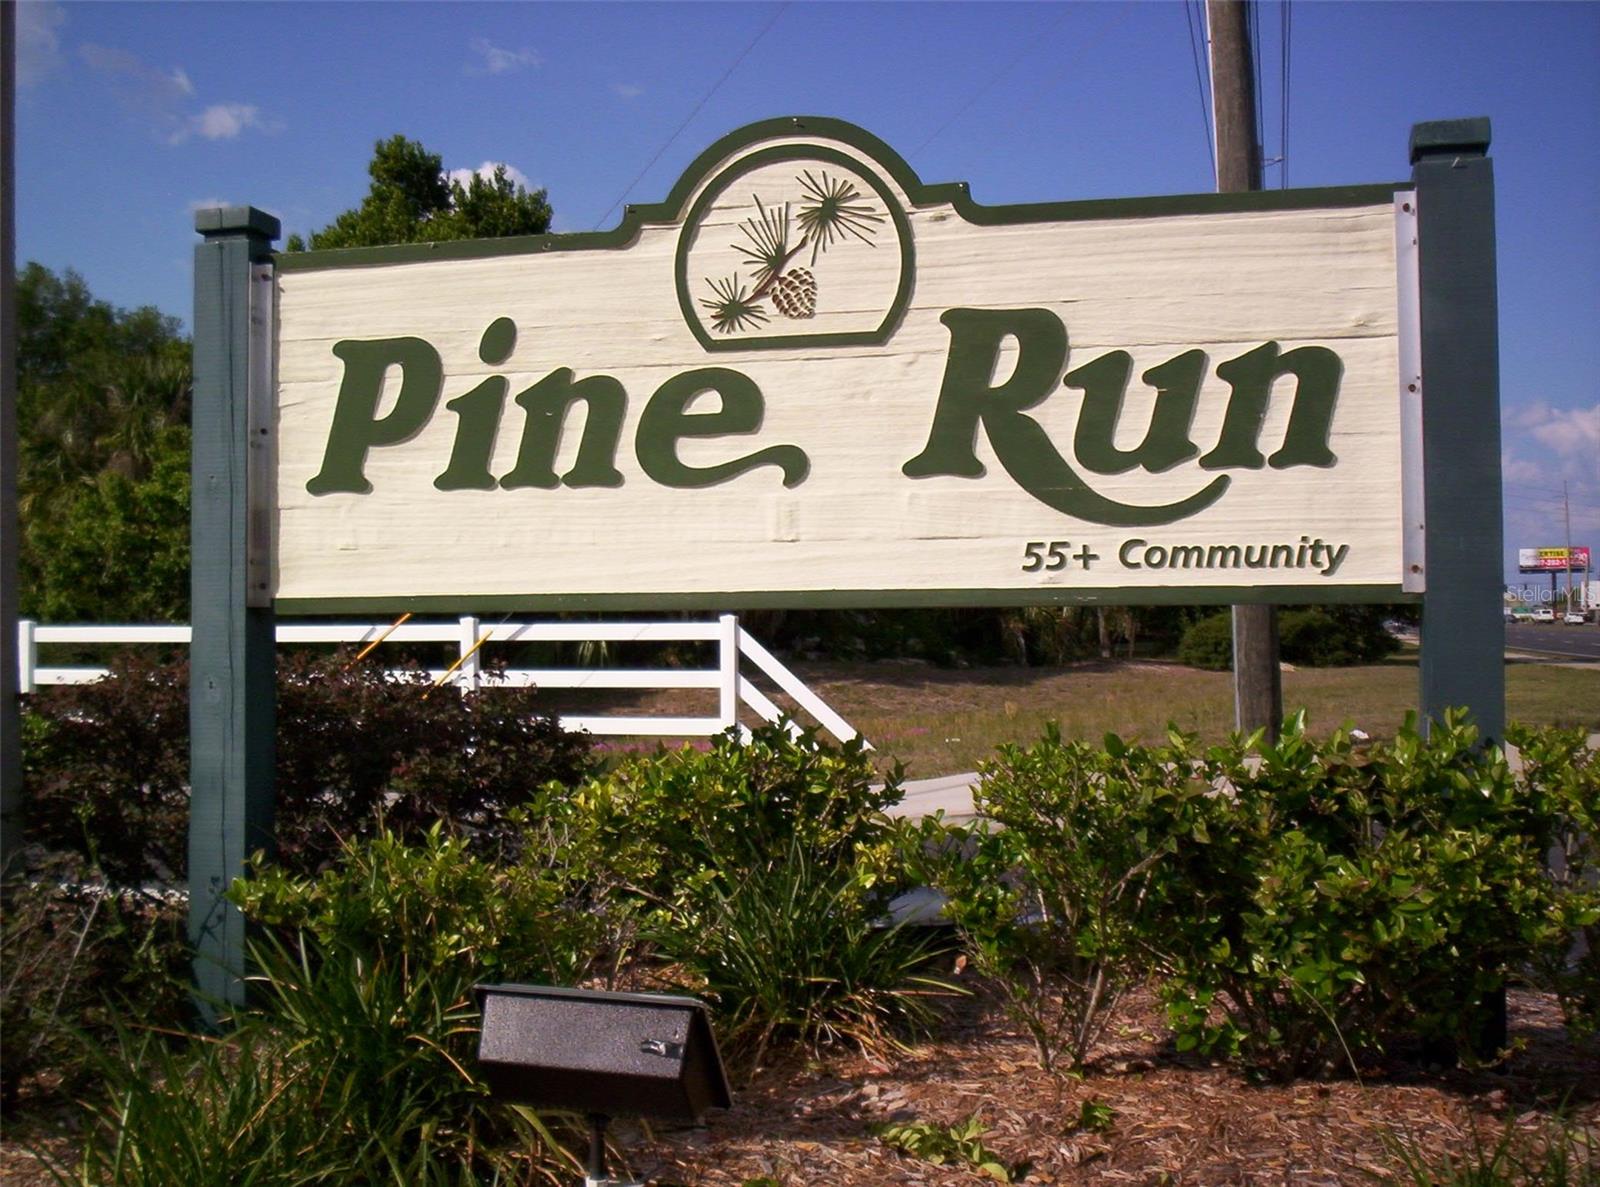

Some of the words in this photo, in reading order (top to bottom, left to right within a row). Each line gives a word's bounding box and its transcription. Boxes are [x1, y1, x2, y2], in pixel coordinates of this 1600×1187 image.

[305, 316, 811, 495] Pine
[902, 307, 1344, 527] Run
[1022, 540, 1099, 572] 55+
[1117, 536, 1350, 576] Community
